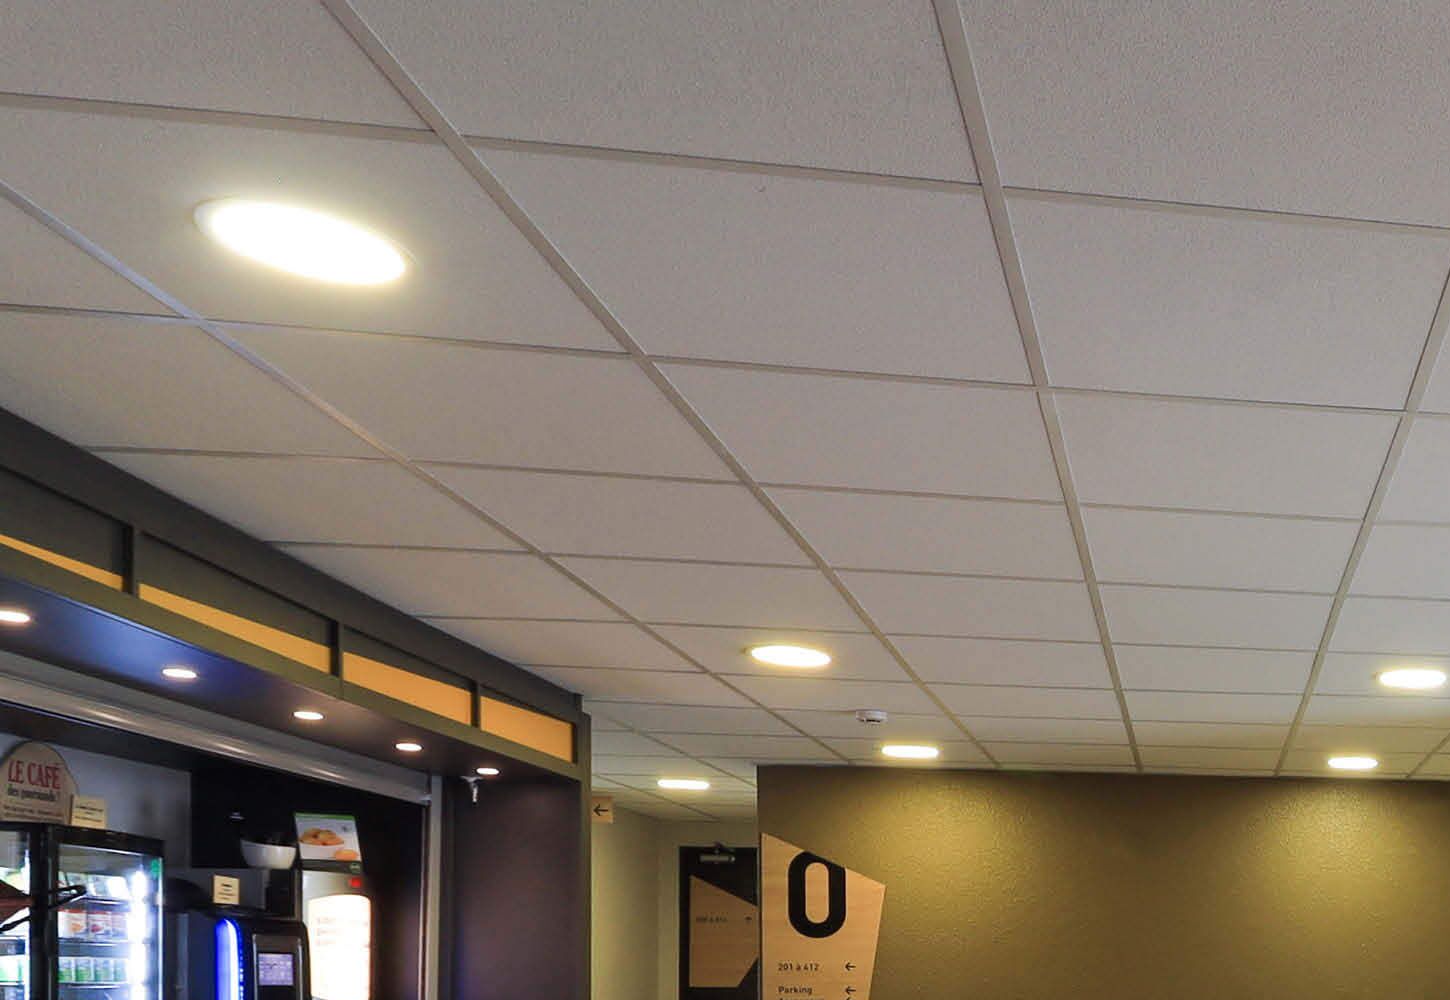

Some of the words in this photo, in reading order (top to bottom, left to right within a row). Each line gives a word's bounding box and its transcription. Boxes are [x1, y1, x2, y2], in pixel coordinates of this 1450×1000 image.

[8, 760, 24, 784] LE
[778, 963, 793, 972] 201
[803, 963, 820, 972] 412
[778, 985, 813, 996] Parking
